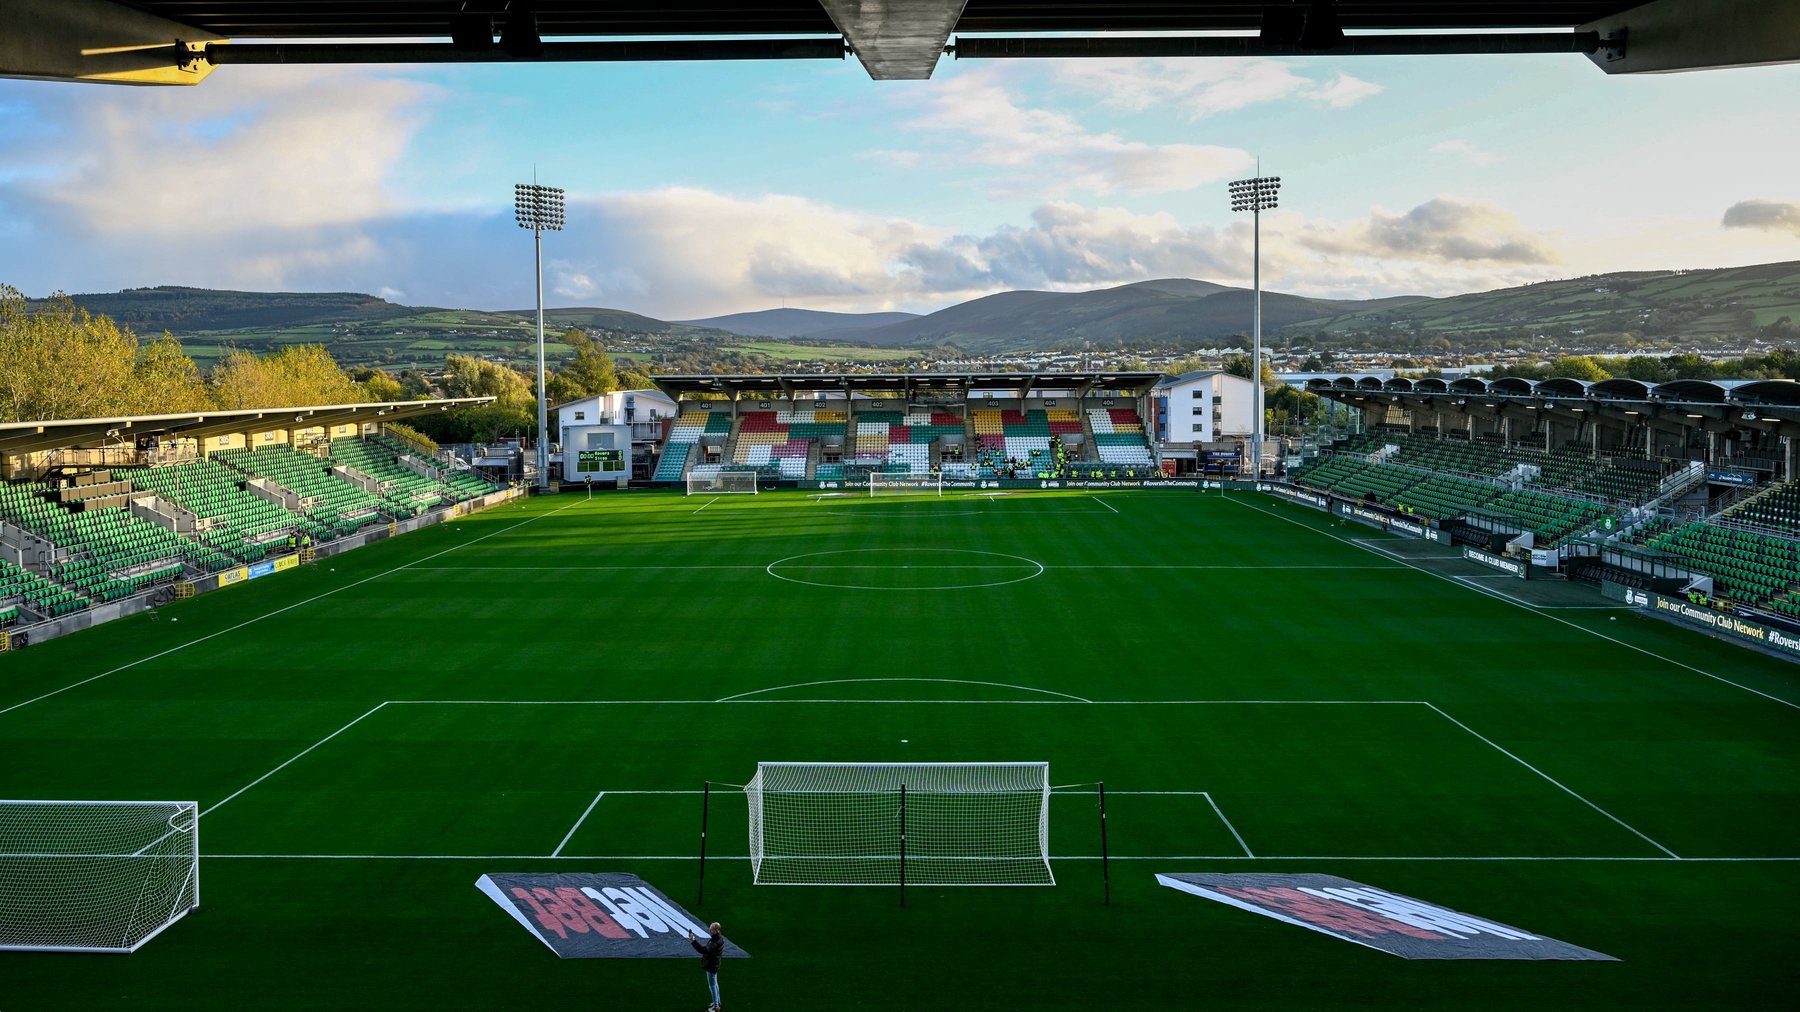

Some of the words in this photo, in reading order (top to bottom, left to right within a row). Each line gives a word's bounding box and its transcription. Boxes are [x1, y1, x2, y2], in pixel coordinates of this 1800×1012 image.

[1468, 549, 1485, 562] BECOME
[1488, 556, 1500, 567] CLUB
[1499, 560, 1519, 573] MEMBER
[1657, 597, 1669, 609] Join
[1669, 602, 1681, 613] our
[1680, 604, 1717, 626] Community
[1717, 615, 1733, 629] Club
[1733, 619, 1764, 639] Network
